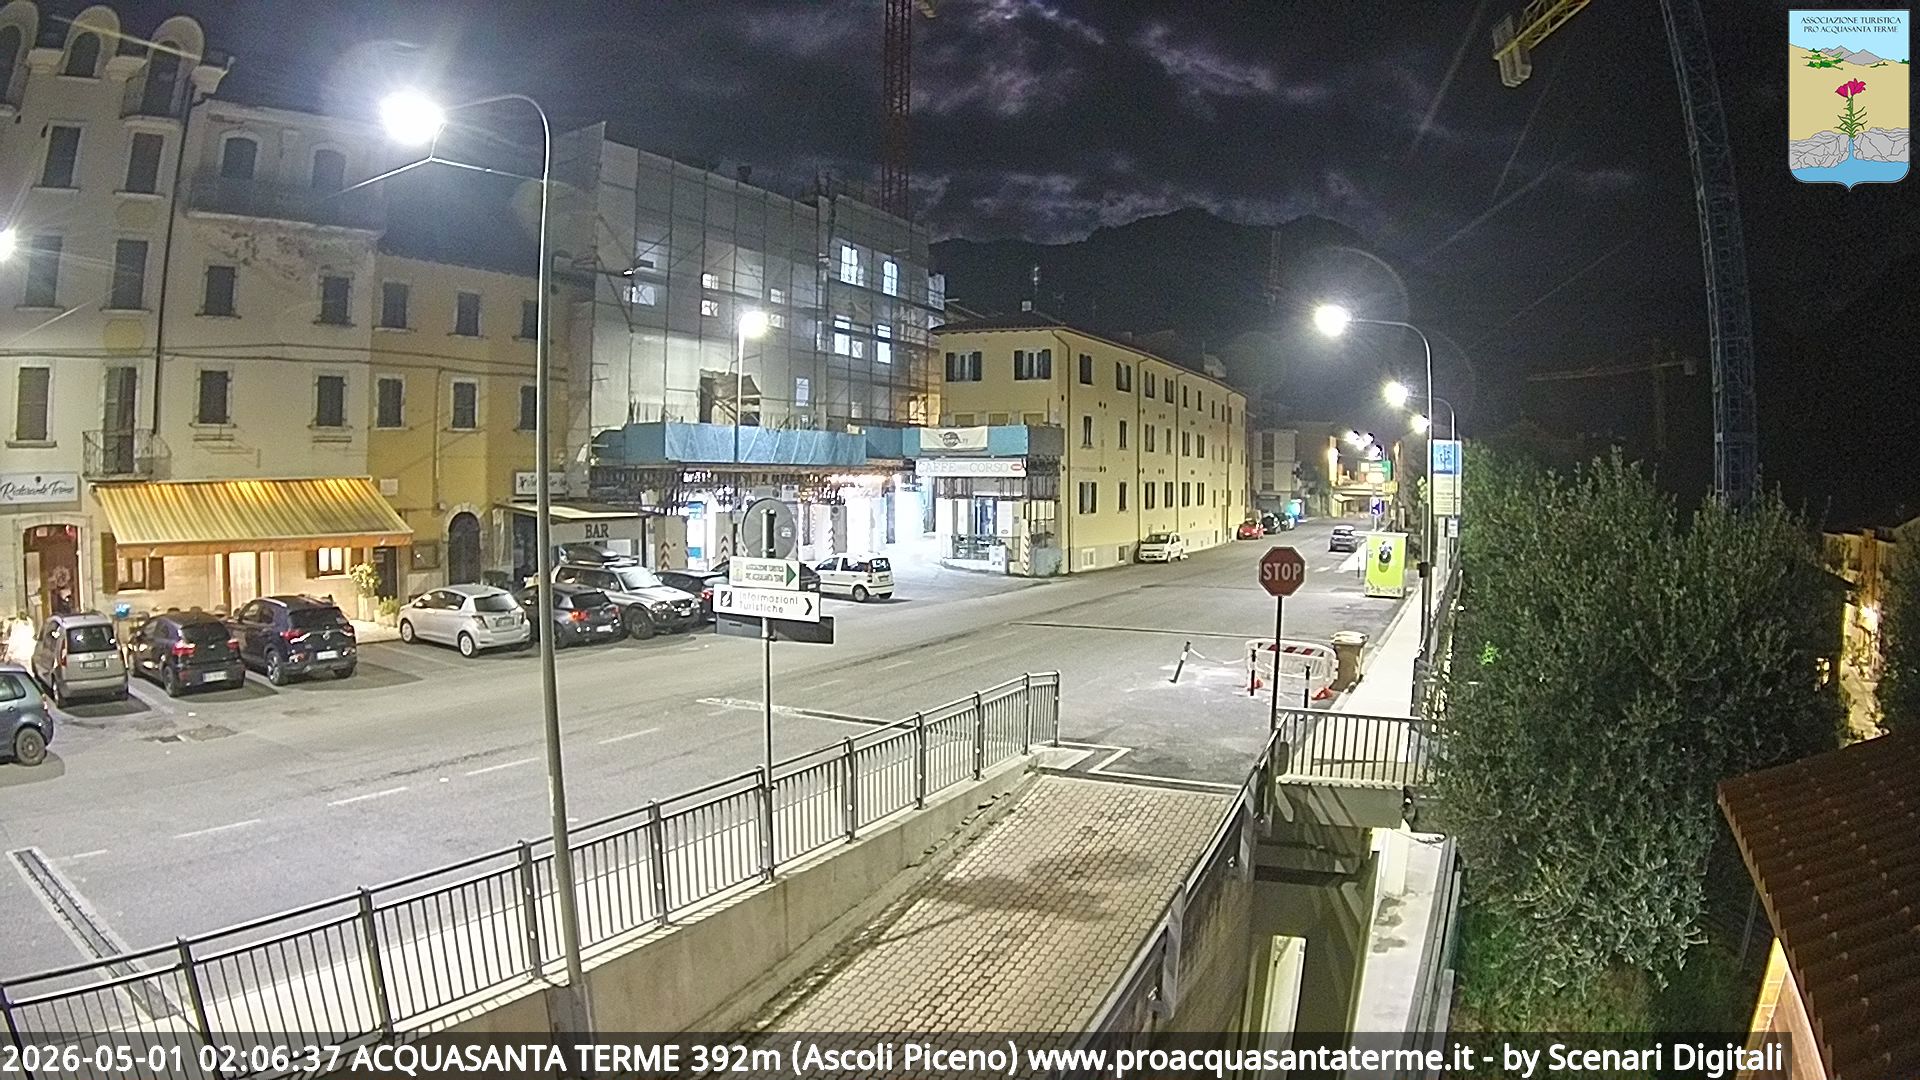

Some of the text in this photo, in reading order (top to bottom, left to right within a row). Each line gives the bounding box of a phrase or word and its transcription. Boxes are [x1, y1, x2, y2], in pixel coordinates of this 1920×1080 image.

[969, 462, 1009, 473] CORSO
[585, 523, 609, 539] BAR
[1263, 563, 1302, 580] STOP
[739, 591, 799, 605] Informazioni
[739, 600, 784, 614] Turistiche
